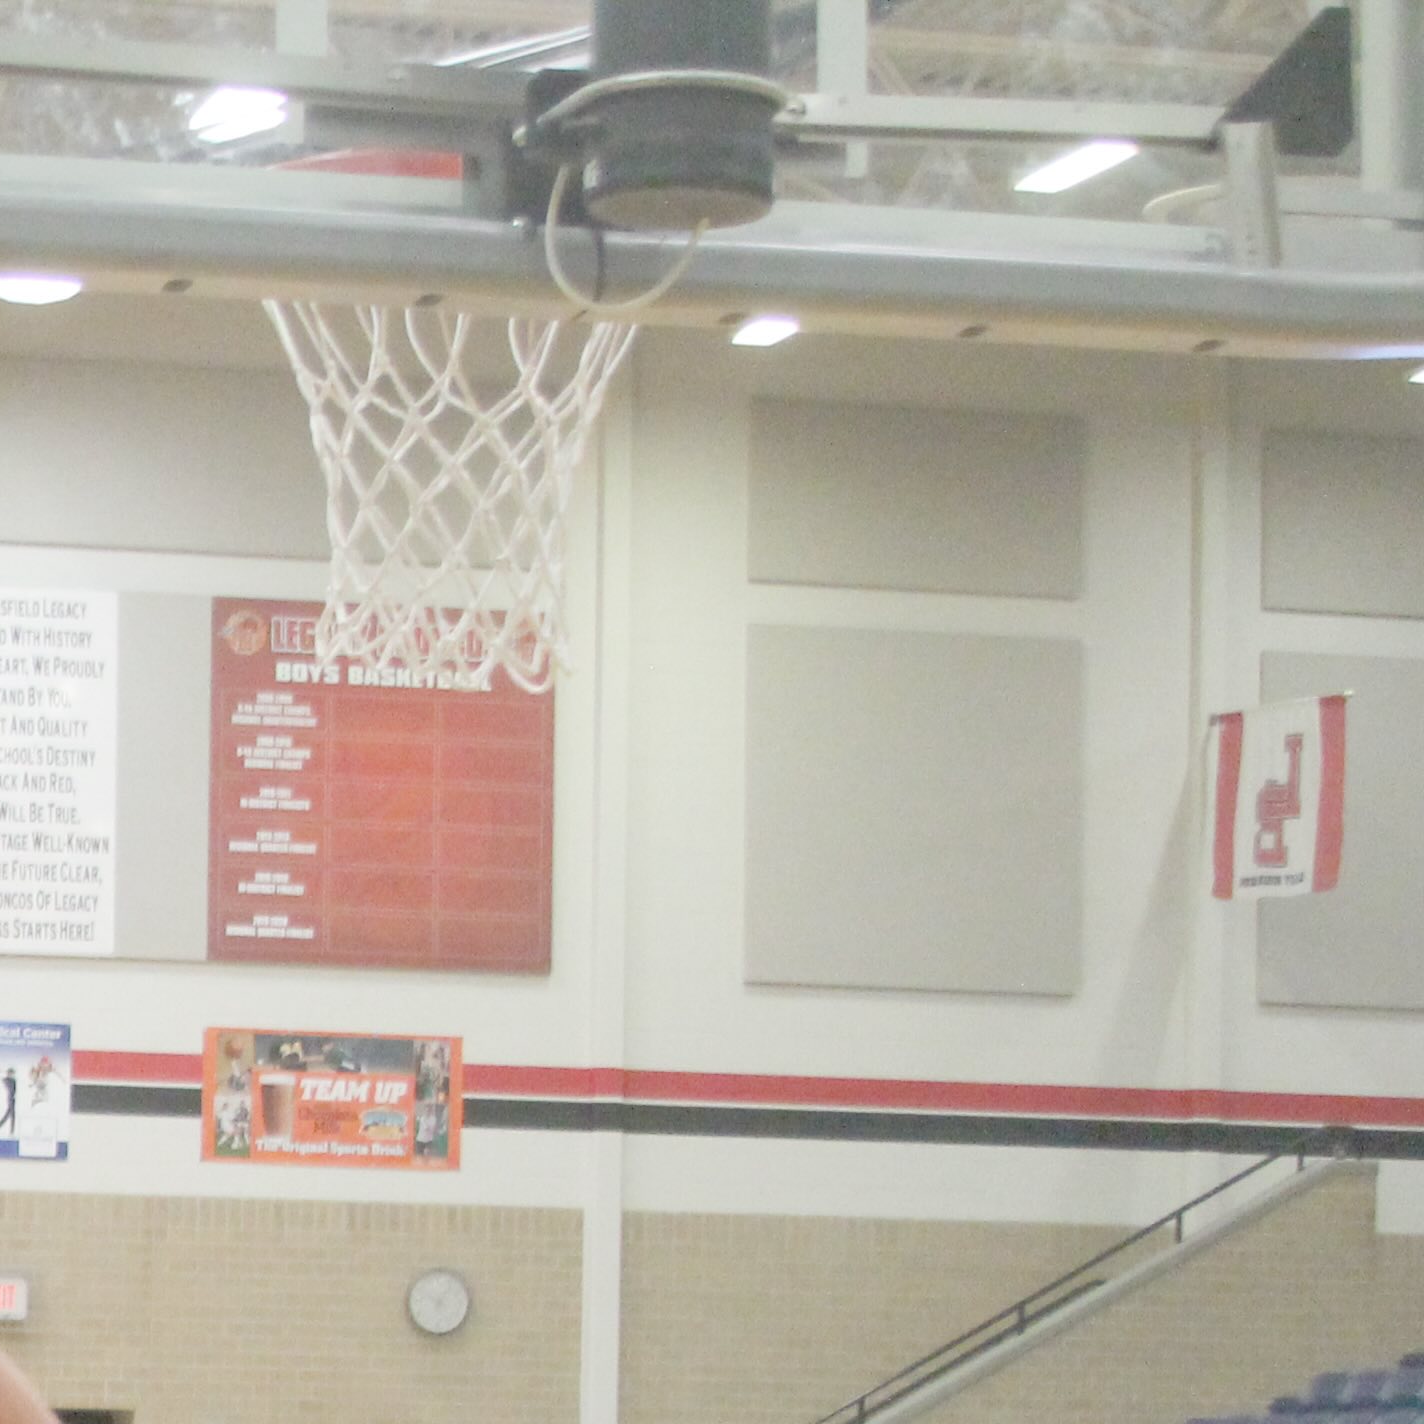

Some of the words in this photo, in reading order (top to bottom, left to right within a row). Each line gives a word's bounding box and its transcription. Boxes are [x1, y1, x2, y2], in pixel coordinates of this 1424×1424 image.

[42, 599, 87, 620] LEGACY
[10, 626, 40, 647] WITH
[43, 627, 93, 648] HISTORY
[32, 656, 50, 677] WE
[53, 657, 105, 679] PROUDLY
[275, 661, 340, 684] BOYS
[27, 686, 42, 707] BY
[10, 715, 34, 736] AND
[37, 716, 88, 738] QUALITY
[47, 746, 95, 768] DESTINY
[22, 772, 46, 793] AND
[29, 803, 44, 823] BE
[11, 861, 57, 882] FUTURE
[36, 890, 51, 911] OF
[54, 892, 98, 912] LEGACY
[13, 919, 57, 940] STARTS
[23, 1026, 62, 1040] Center
[300, 1078, 370, 1103] TEAM
[374, 1082, 408, 1104] UP
